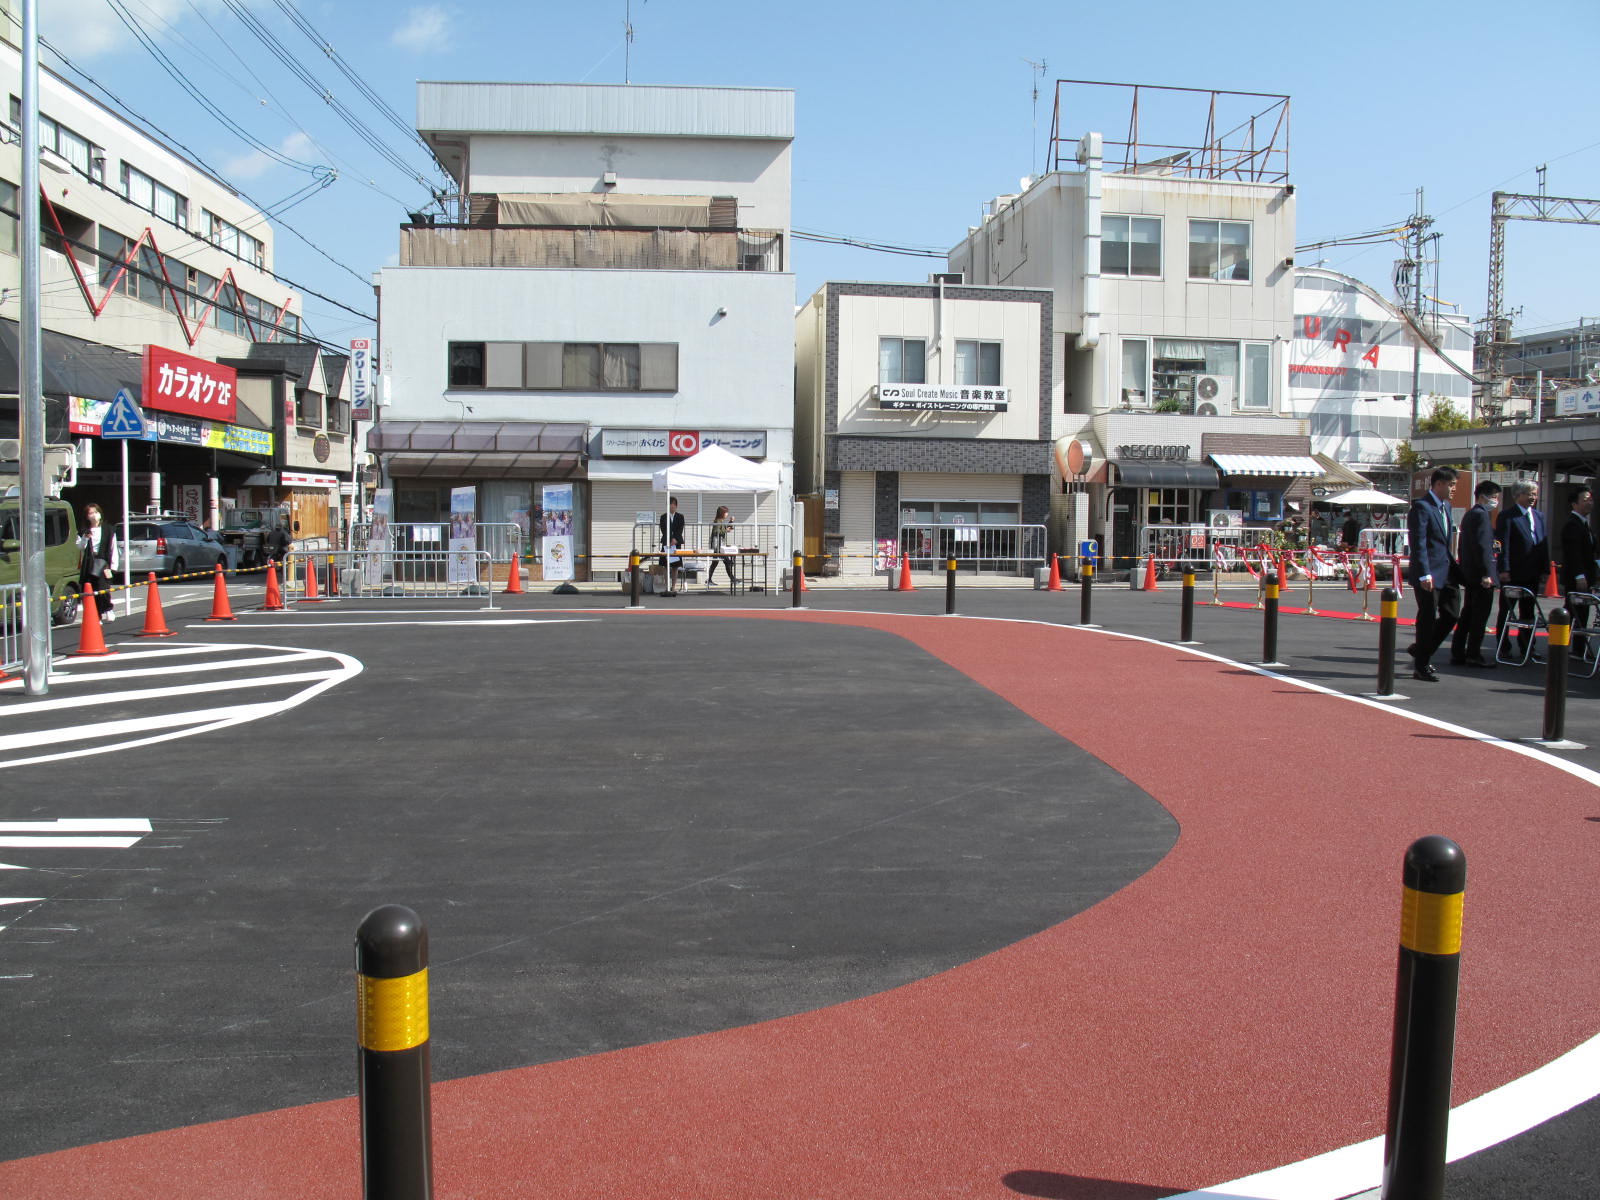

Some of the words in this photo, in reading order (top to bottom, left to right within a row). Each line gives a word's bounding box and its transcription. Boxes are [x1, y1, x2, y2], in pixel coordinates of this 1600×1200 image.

[158, 363, 217, 404] カラオケ
[218, 381, 232, 405] 2F
[354, 350, 366, 408] クリーニング
[901, 388, 916, 398] Soul
[917, 389, 938, 399] Create
[940, 389, 958, 399] Music
[960, 389, 1005, 400] 音楽教室
[702, 438, 763, 449] クリーニング
